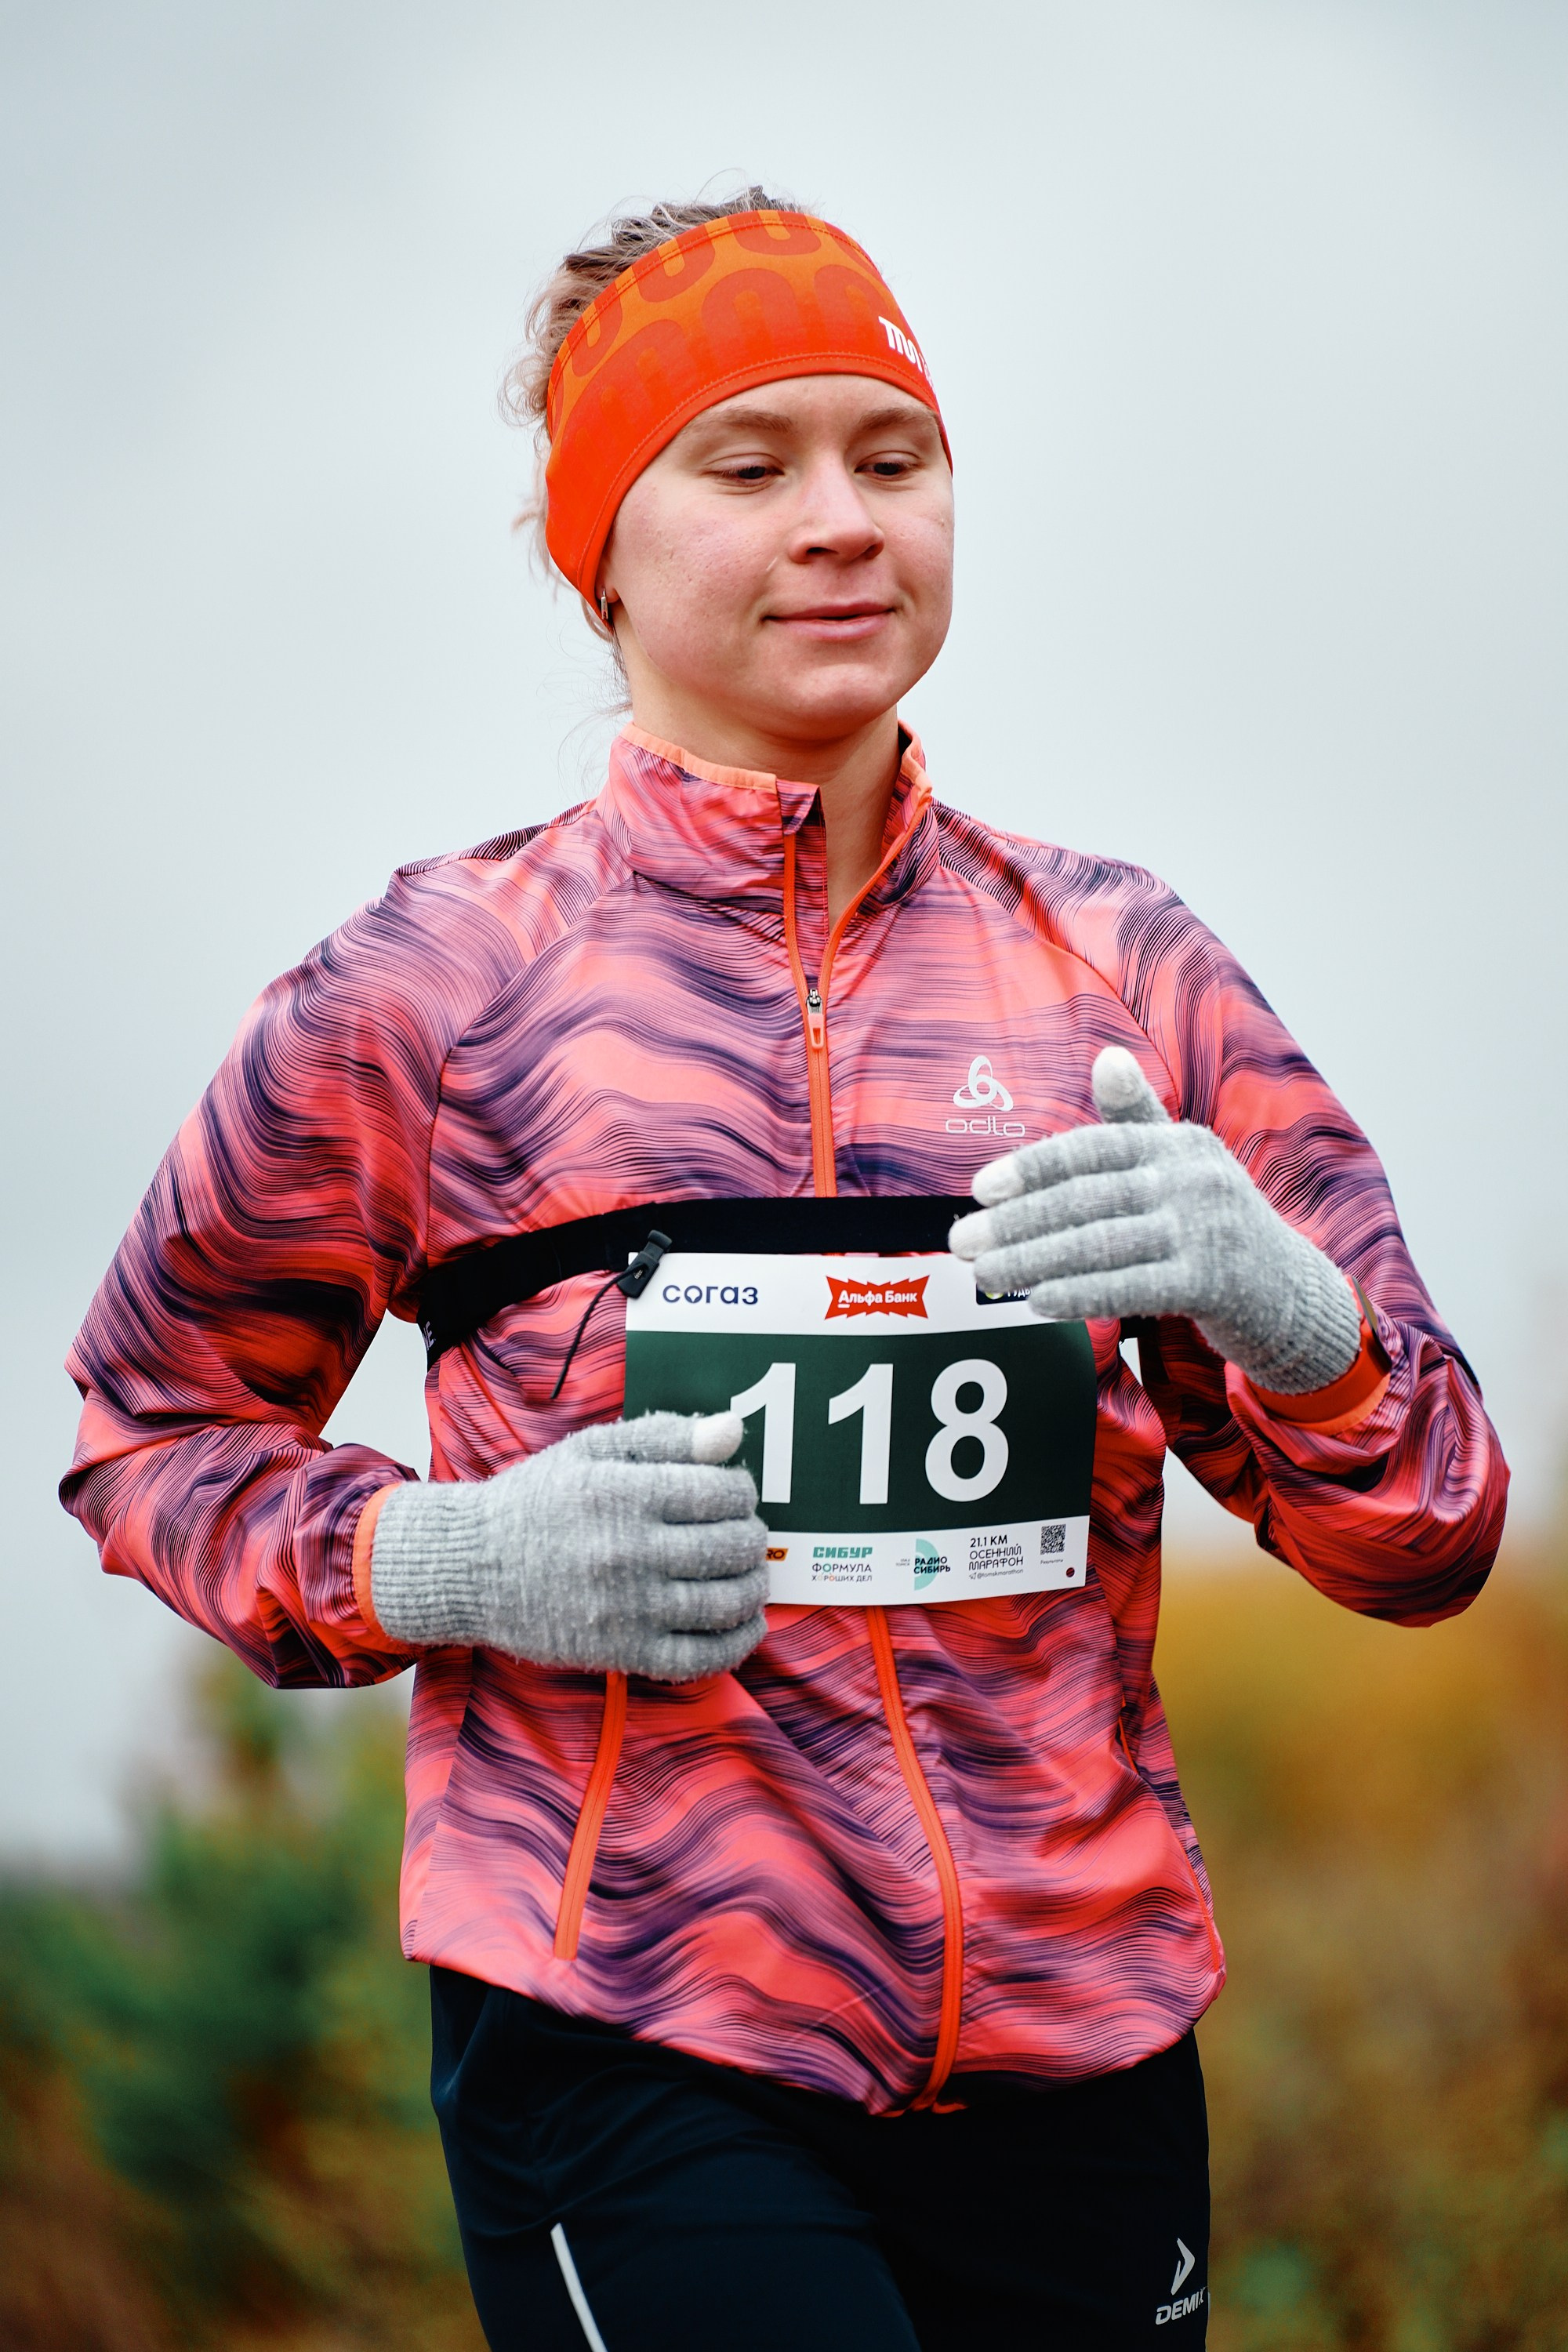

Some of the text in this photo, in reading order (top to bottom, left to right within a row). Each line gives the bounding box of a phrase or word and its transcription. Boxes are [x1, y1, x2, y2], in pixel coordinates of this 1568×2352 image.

[946, 1116, 1025, 1138] odlo
[837, 1290, 918, 1308] Альфа Банк
[730, 1358, 1009, 1504] 118
[970, 1537, 987, 1548] 21.1
[812, 1547, 873, 1559] СИБУР
[969, 1544, 1022, 1560] ОСЕННИЙ
[914, 1556, 948, 1566] РАДИО
[968, 1556, 1024, 1571] МАРАФОН
[811, 1563, 872, 1573] ФОРМУЛА
[913, 1565, 951, 1574] СИБИРЬ
